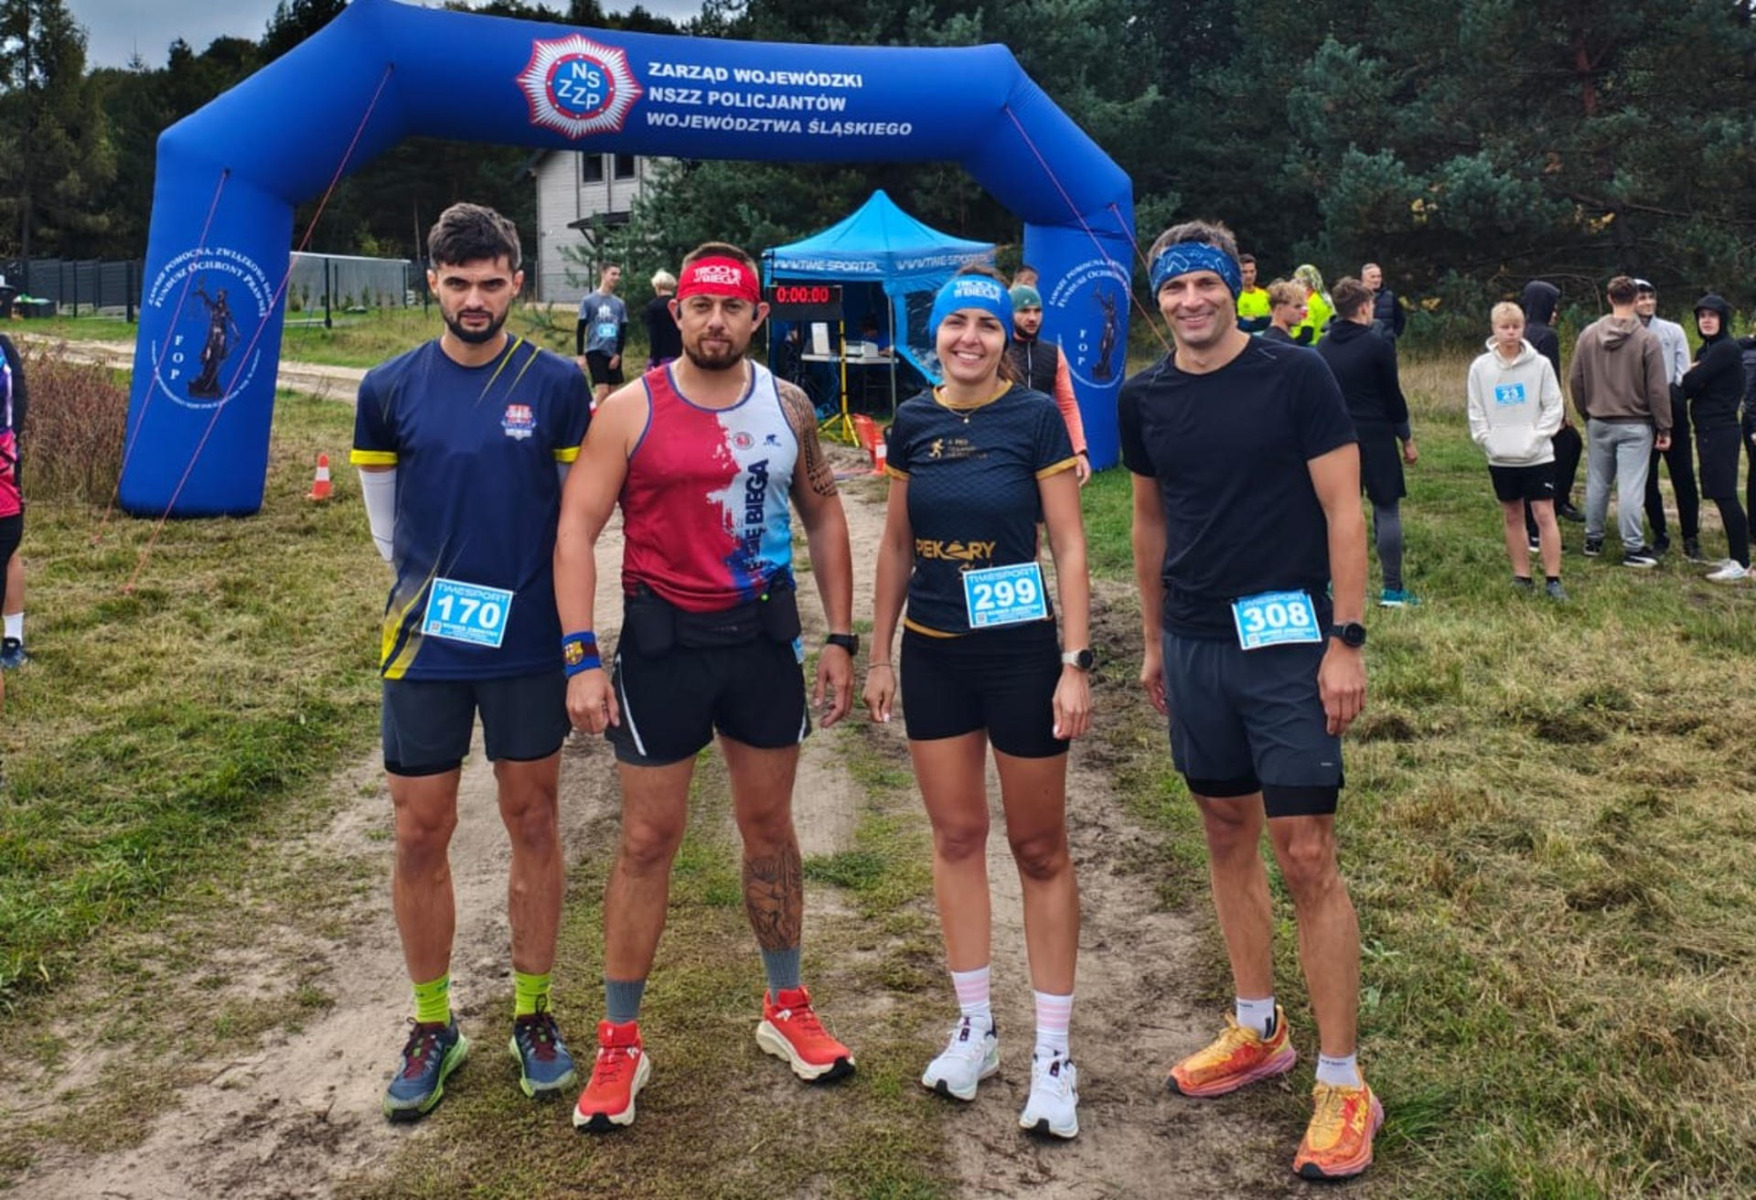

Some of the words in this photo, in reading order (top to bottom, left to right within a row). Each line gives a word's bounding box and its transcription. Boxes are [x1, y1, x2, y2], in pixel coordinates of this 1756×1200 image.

[648, 62, 729, 85] ZARZĄD
[733, 68, 863, 88] WOJEWÓDZKI
[649, 86, 702, 104] NSZZ
[708, 91, 846, 112] POLICJANTÓW
[647, 112, 802, 133] WOJEWÓDZTWA
[808, 118, 912, 137] ŚLĄSKIEGO
[745, 459, 769, 525] BIEGA
[973, 577, 1037, 611] 299
[437, 594, 501, 630] 170
[1242, 602, 1310, 632] 308
